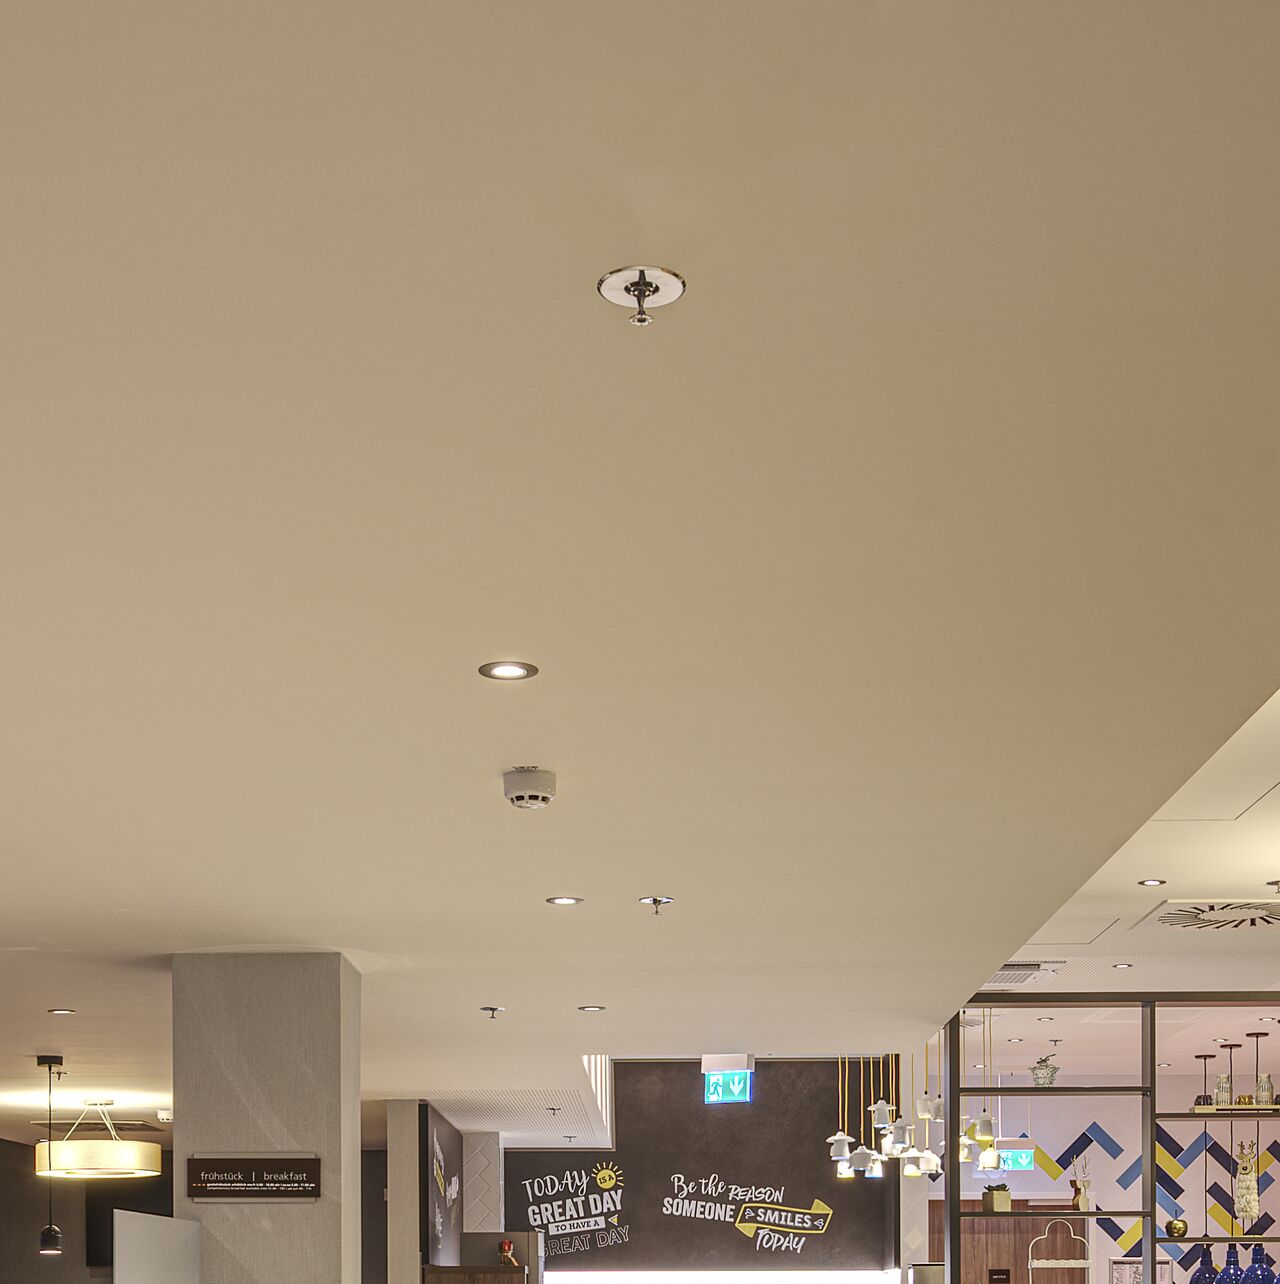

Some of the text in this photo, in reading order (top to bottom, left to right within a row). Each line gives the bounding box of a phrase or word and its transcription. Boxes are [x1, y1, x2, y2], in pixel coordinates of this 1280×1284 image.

[263, 1171, 307, 1181] breakfast
[521, 1169, 590, 1203] TODAY
[598, 1176, 607, 1185] IS
[671, 1173, 785, 1204] Be the REASON
[527, 1189, 623, 1227] GREAT DAY
[662, 1197, 736, 1222] SOMEONE
[756, 1208, 812, 1228] SMILES
[555, 1219, 600, 1232] TO HAVE A
[596, 1225, 629, 1248] DAY
[756, 1228, 806, 1254] TODAY
